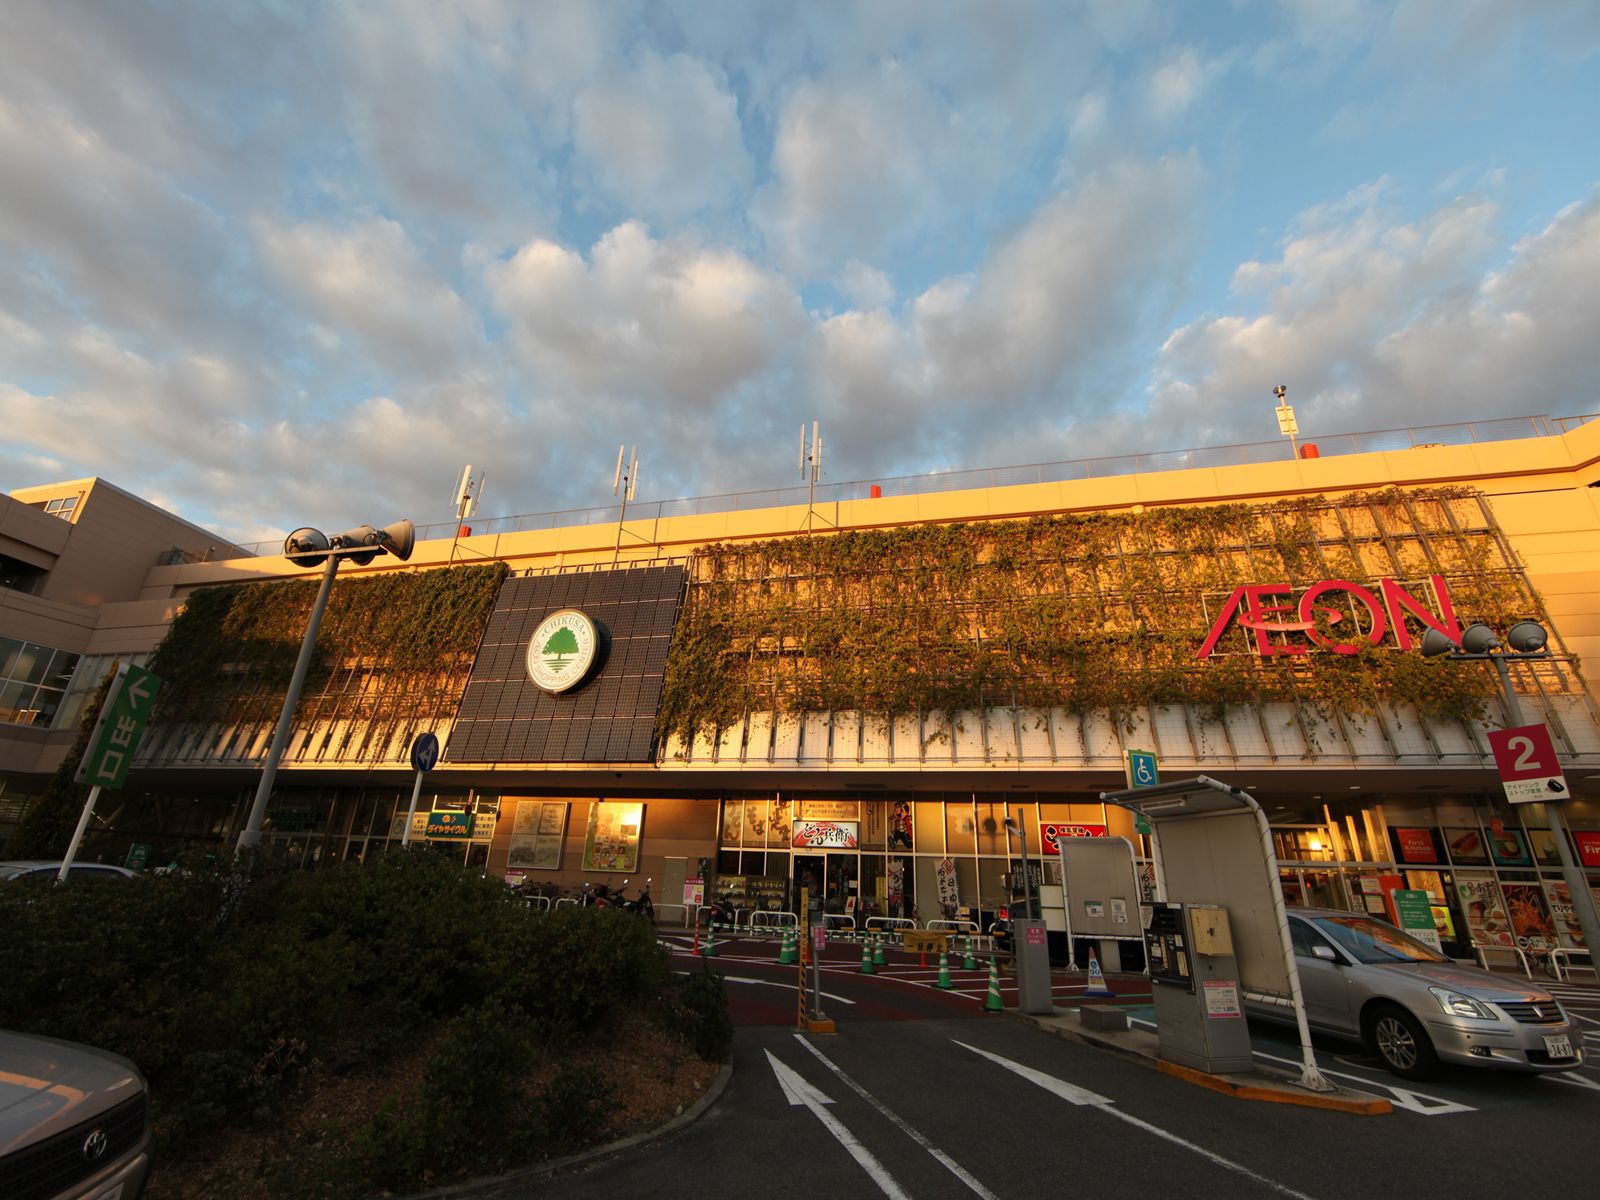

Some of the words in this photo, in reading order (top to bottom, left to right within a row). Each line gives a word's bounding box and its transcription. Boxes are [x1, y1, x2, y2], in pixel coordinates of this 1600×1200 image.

[543, 616, 585, 634] CHIKUSA
[535, 665, 570, 684] SHOPPING
[571, 637, 590, 675] CENTER
[97, 715, 137, 781] 出口
[1507, 735, 1542, 772] 2
[747, 805, 767, 836] そば
[803, 822, 849, 845] どん兵衛
